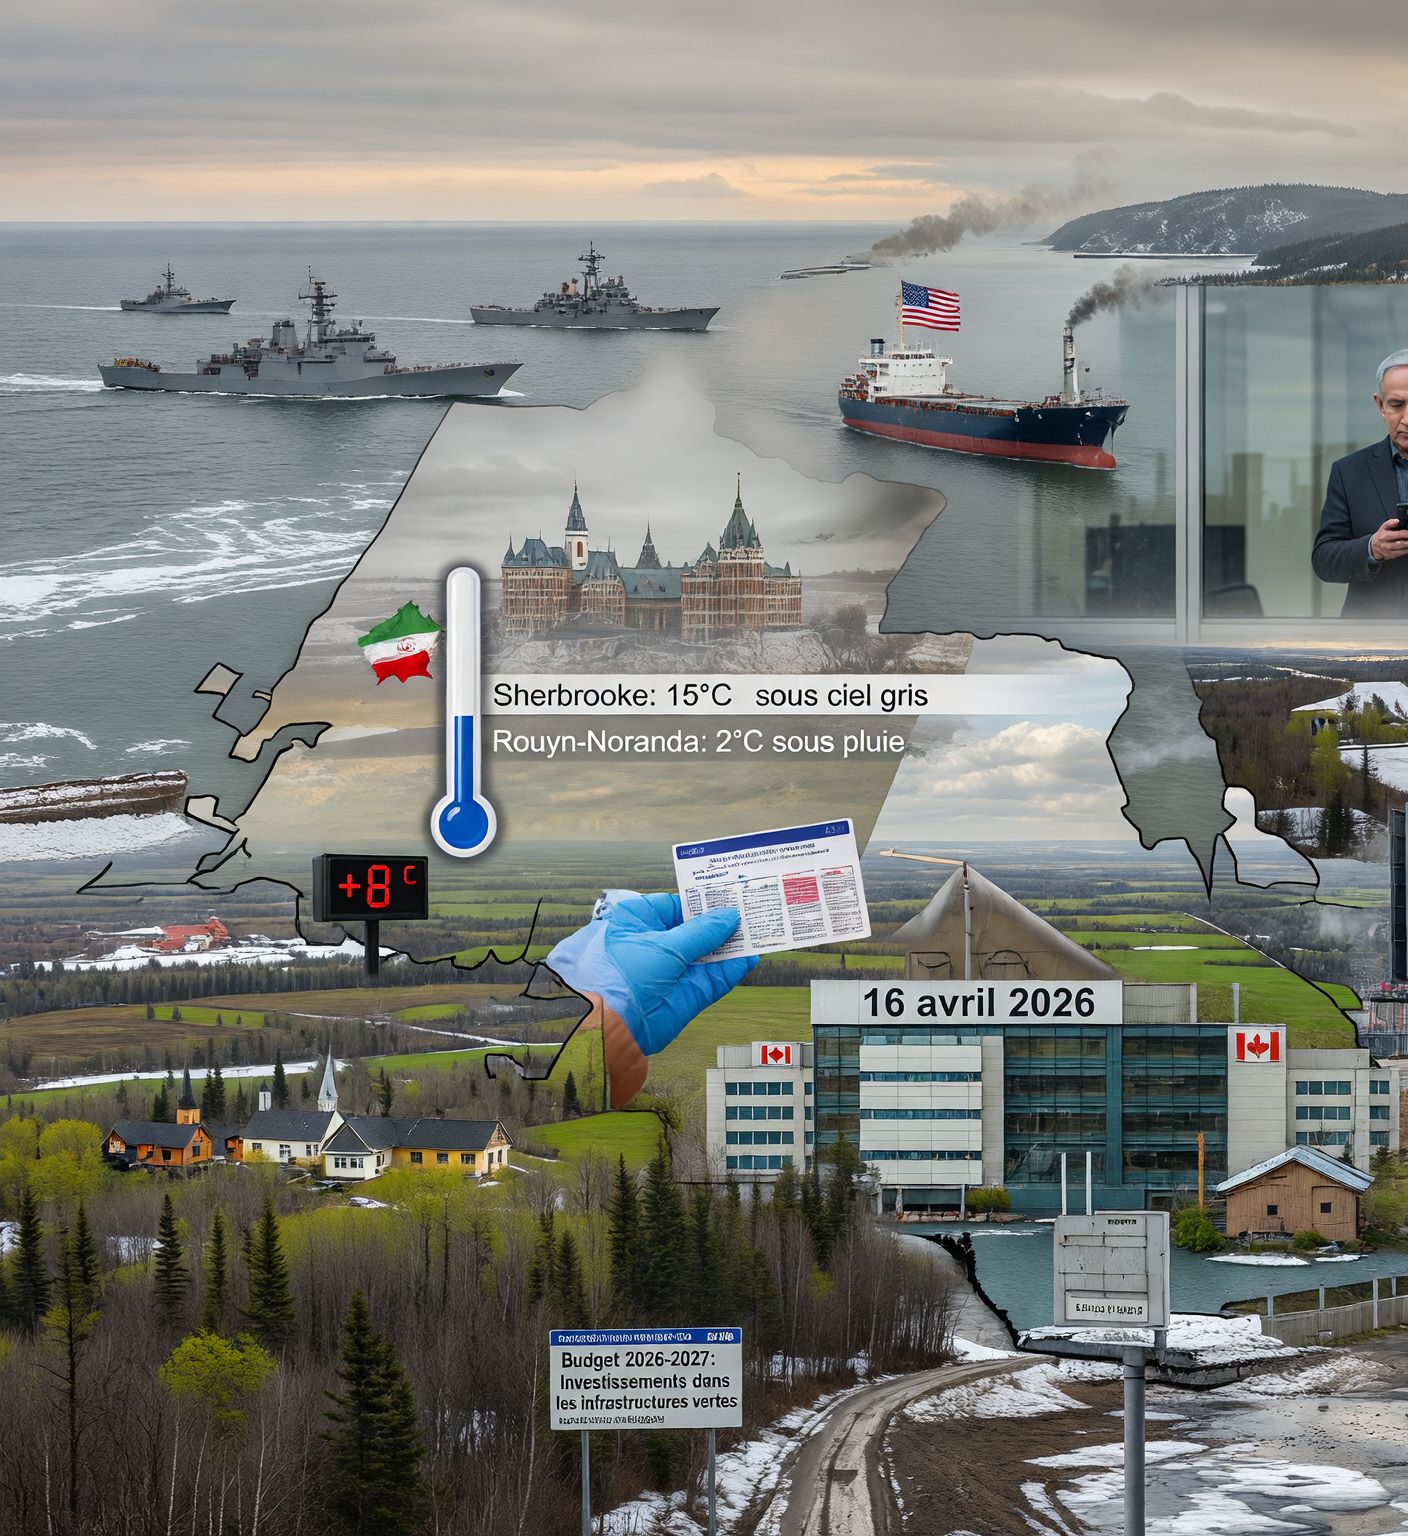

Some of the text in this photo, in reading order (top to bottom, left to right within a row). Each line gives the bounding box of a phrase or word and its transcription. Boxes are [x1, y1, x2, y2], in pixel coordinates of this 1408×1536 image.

[339, 864, 391, 909] +8
[864, 987, 1096, 1018] 16 avril 2026
[562, 1350, 716, 1371] Budget 2026-2027:
[560, 1373, 730, 1390] Investissements dans
[556, 1393, 738, 1411] les infrastructures vertes
